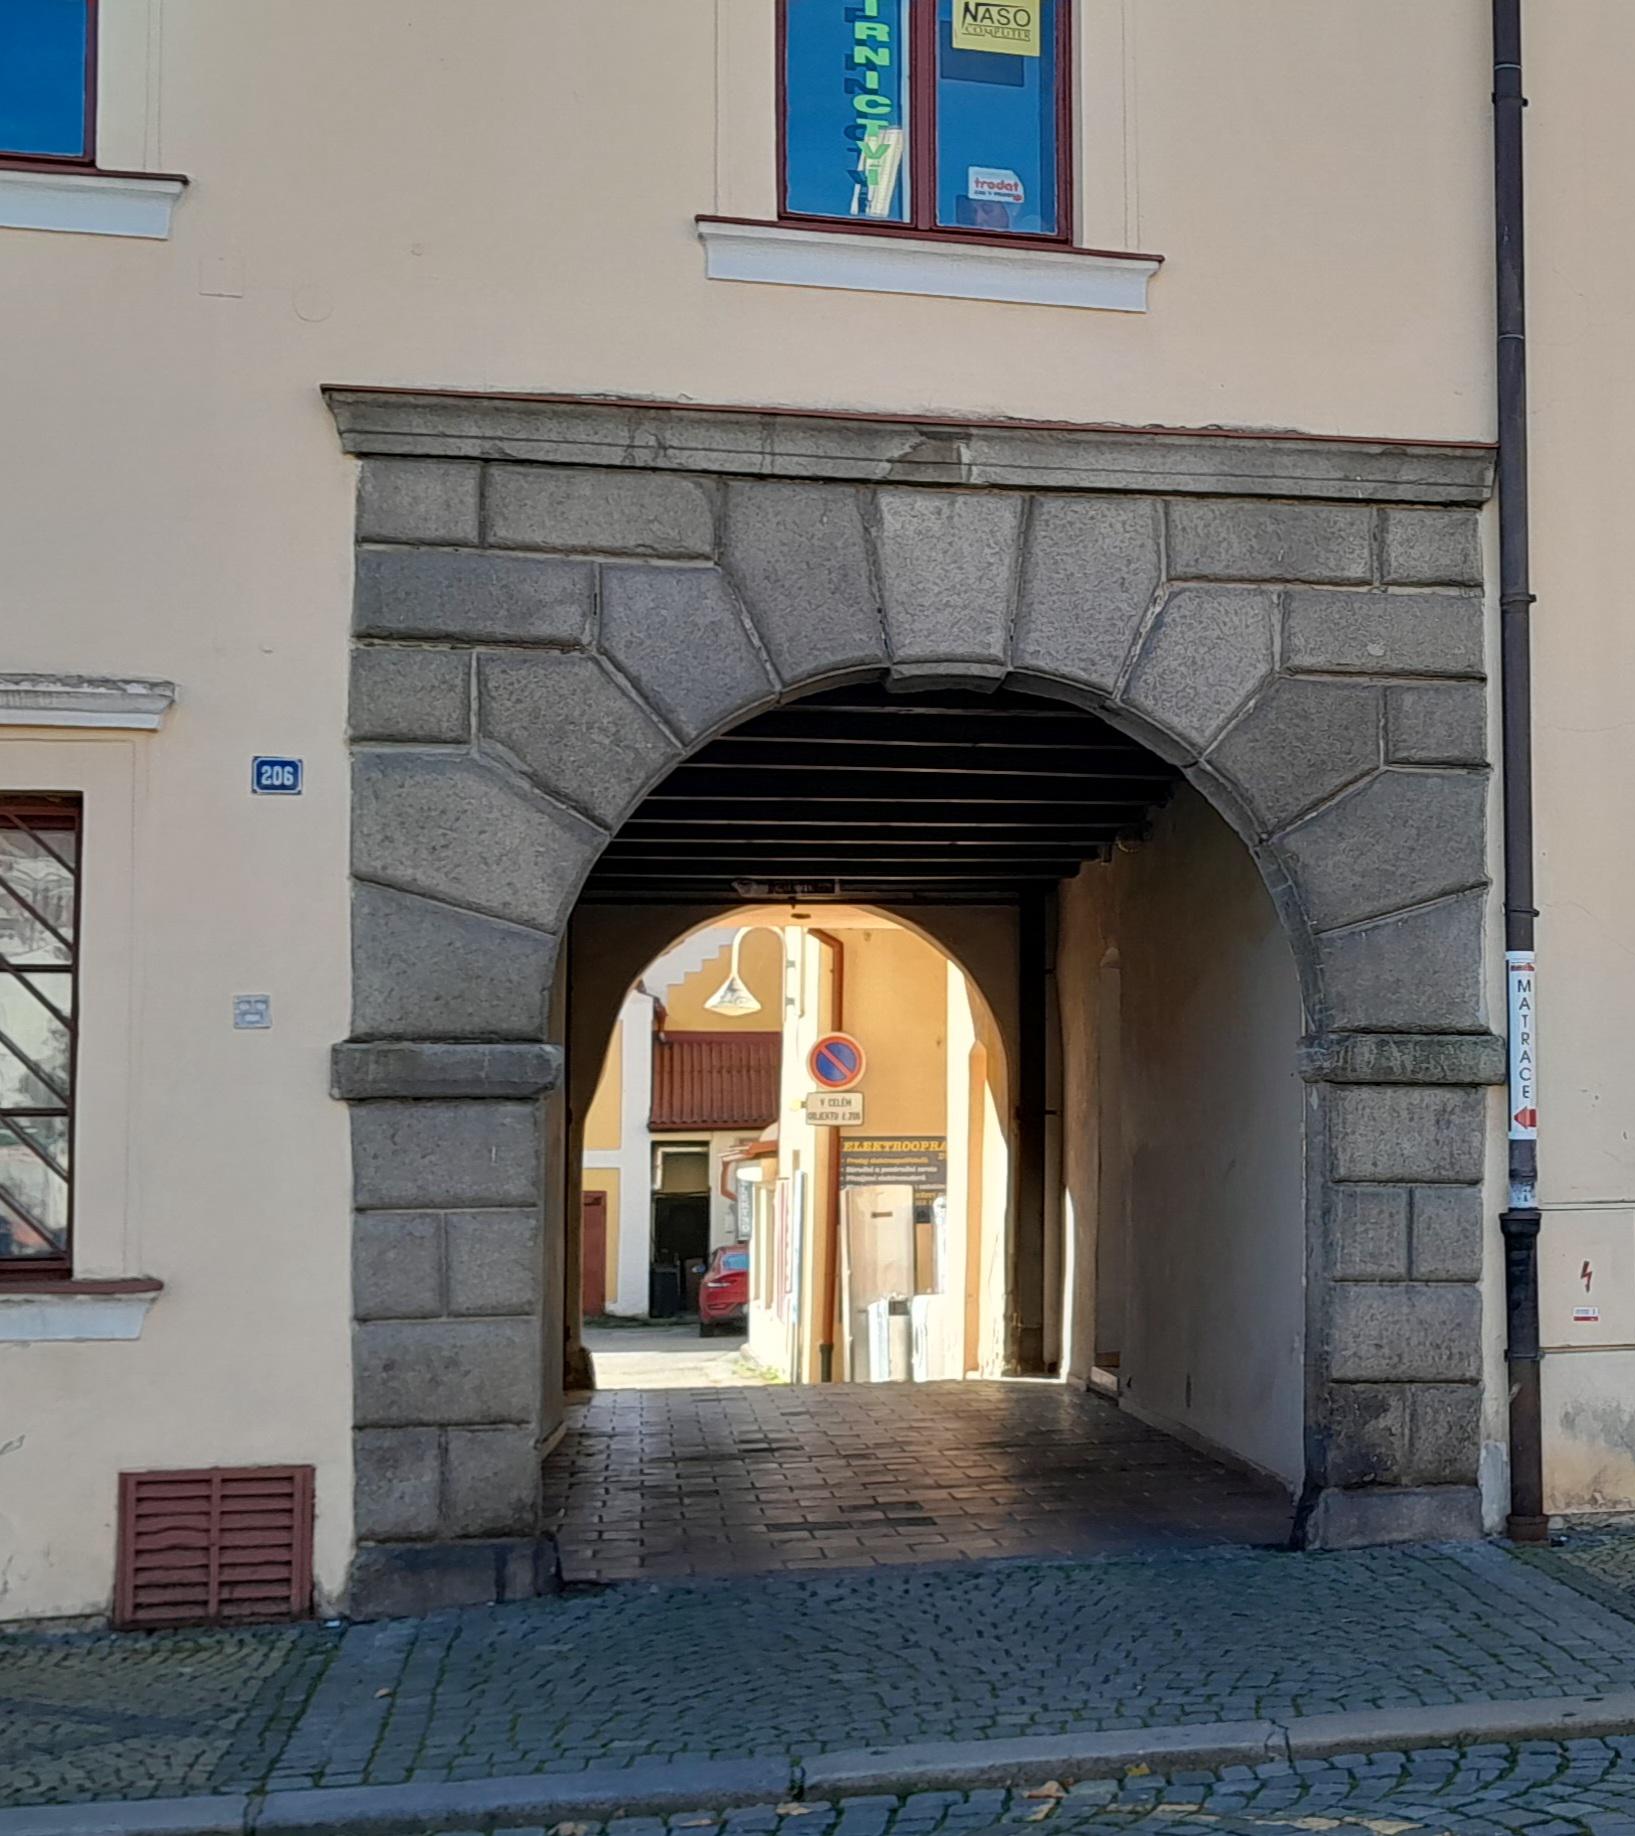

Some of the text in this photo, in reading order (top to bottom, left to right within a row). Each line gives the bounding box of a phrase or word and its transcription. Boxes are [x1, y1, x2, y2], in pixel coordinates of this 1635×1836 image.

[962, 1, 1031, 28] NASO
[974, 177, 1019, 191] trodat
[260, 765, 294, 786] 206
[1516, 978, 1532, 1099] MATRACE
